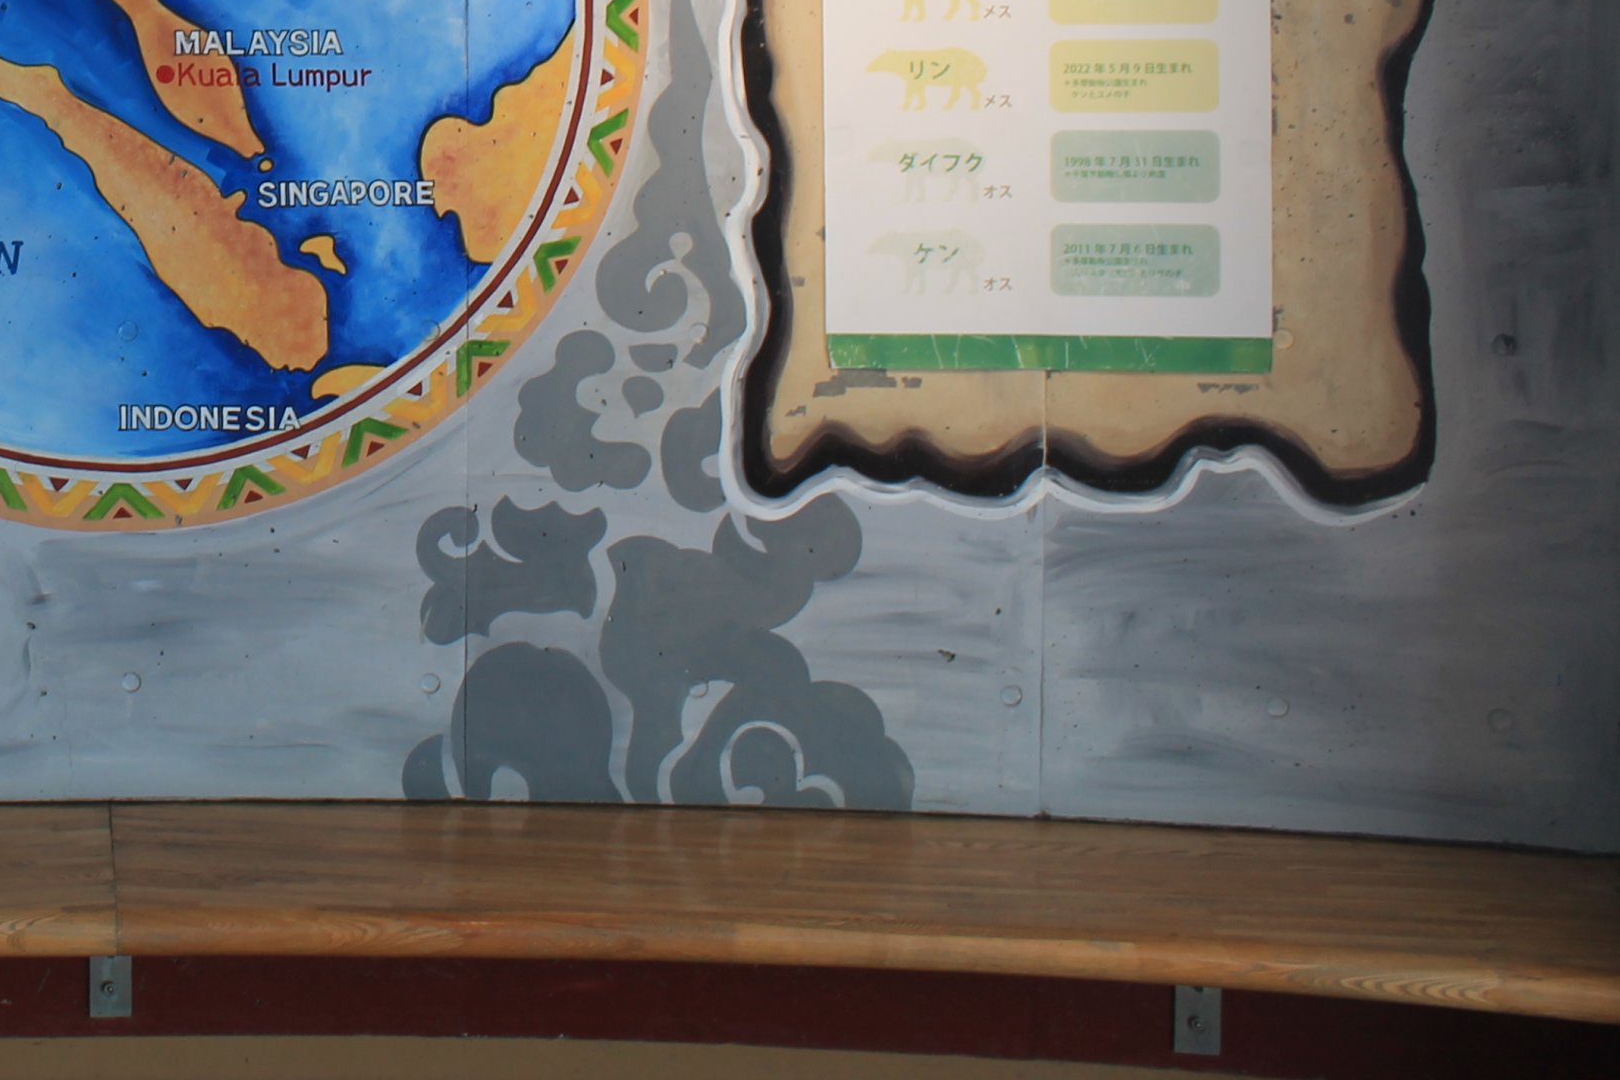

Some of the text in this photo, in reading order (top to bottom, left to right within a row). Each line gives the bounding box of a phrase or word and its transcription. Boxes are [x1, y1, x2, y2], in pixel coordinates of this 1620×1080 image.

[983, 5, 1011, 18] メス
[174, 29, 343, 56] MALAYSIA
[178, 63, 371, 92] Kuala Lumpur
[909, 60, 951, 79] リン
[984, 95, 1012, 108] メス
[899, 152, 983, 173] ダイフク
[257, 180, 435, 208] SINGAPORE
[983, 185, 1012, 199] オス
[914, 243, 959, 264] ケン
[984, 277, 1012, 291] オス
[119, 405, 301, 431] INDONESIA
